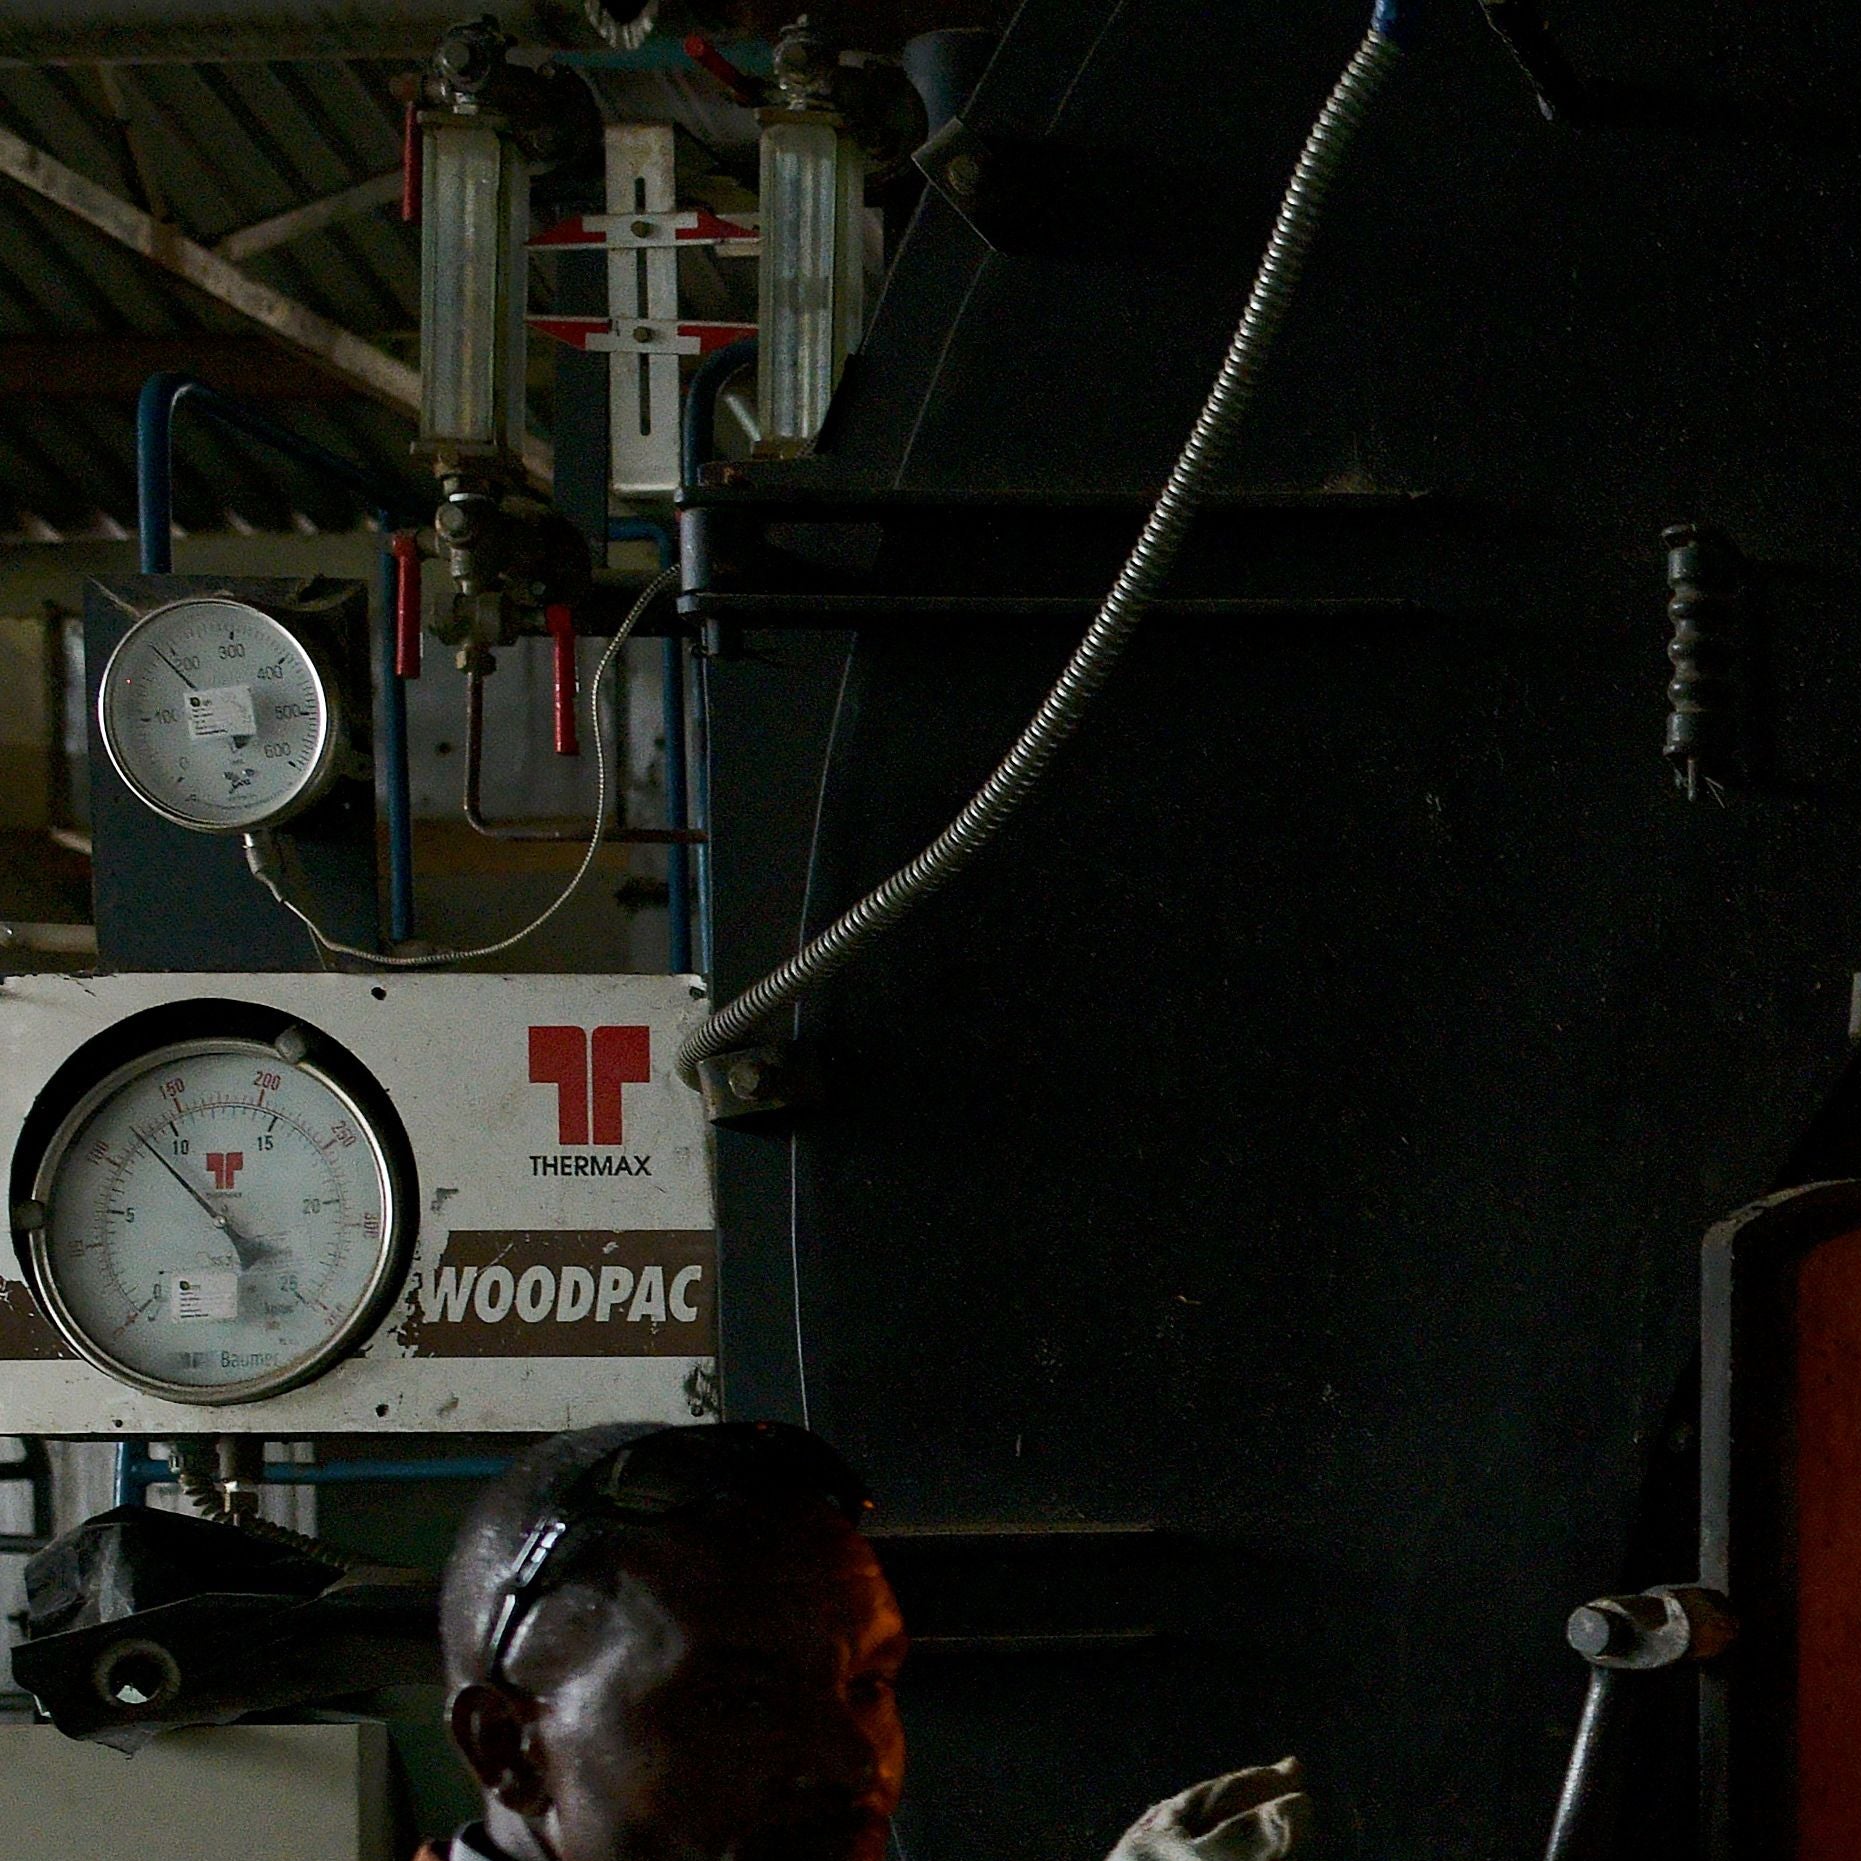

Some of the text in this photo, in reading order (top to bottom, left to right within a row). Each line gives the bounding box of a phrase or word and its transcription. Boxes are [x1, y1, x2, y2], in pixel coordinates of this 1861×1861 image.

[159, 1078, 185, 1099] 150
[254, 1071, 281, 1090] 200
[172, 1139, 189, 1155] 10
[257, 1135, 274, 1151] 15
[528, 1156, 652, 1176] THERMAX
[303, 1198, 320, 1214] 20
[126, 1207, 135, 1223] 5
[420, 1264, 702, 1324] WOODPAC
